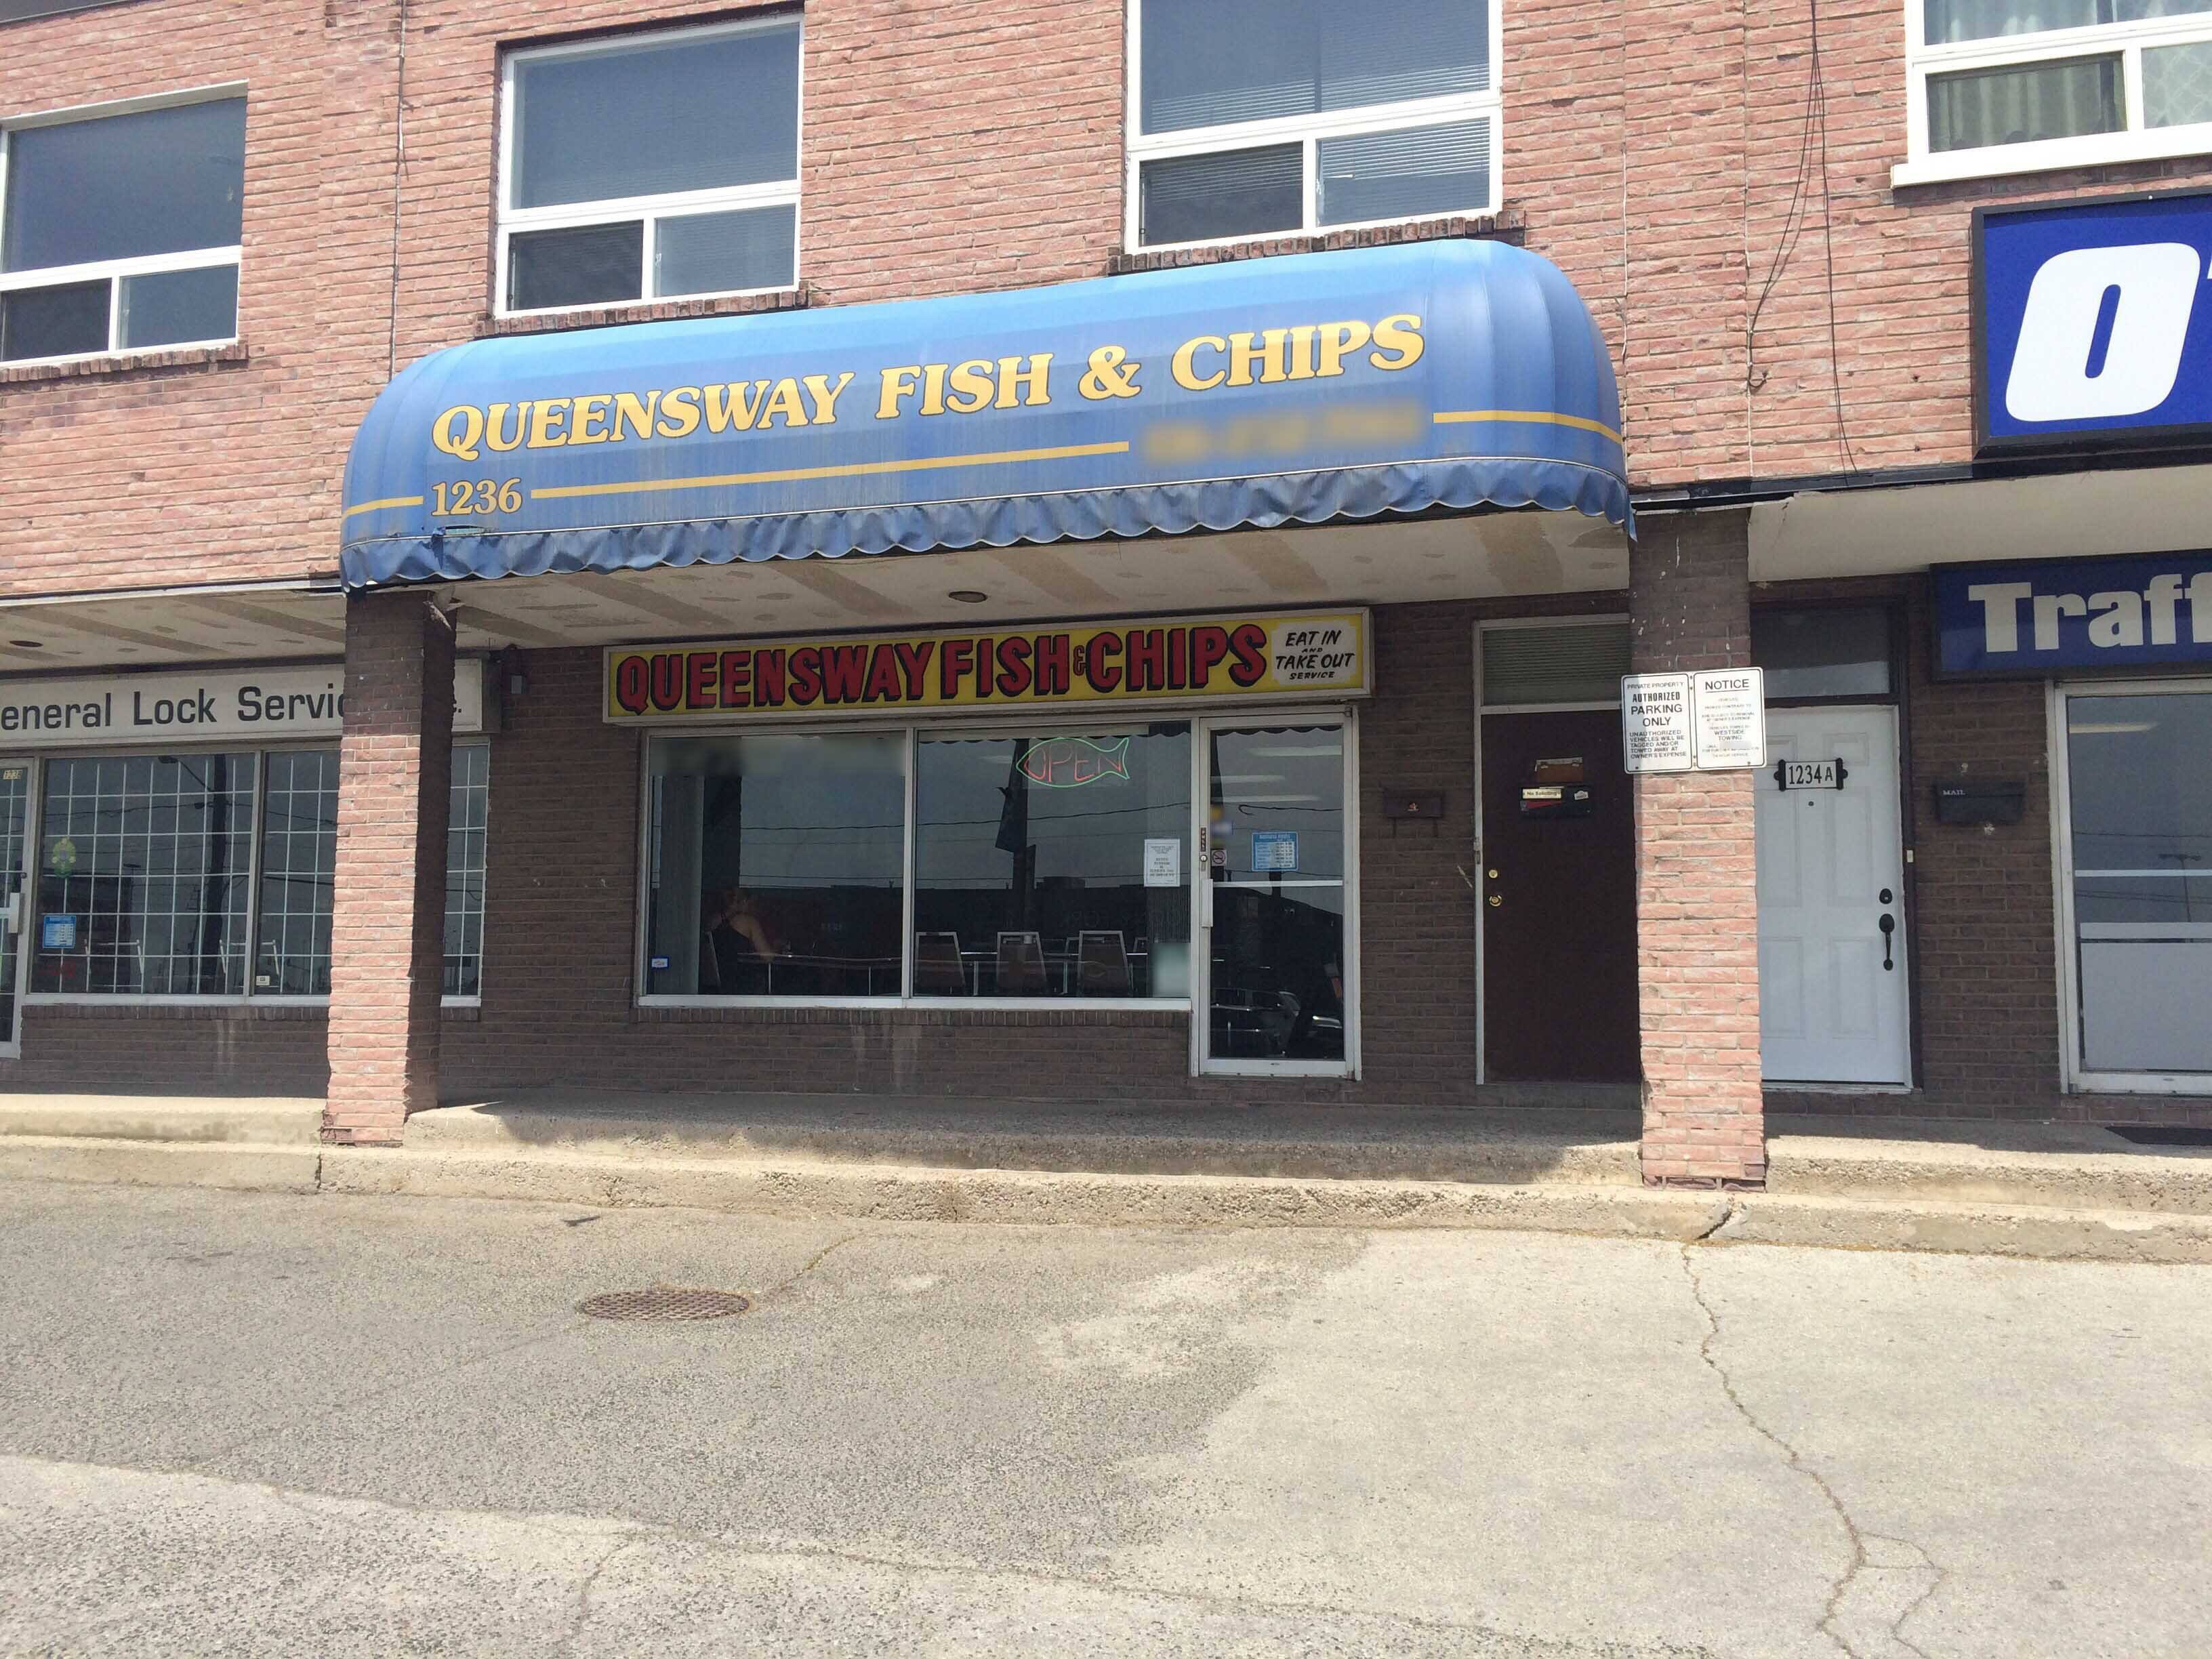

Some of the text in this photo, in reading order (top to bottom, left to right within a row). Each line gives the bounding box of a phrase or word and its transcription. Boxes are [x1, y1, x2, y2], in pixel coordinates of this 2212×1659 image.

[2006, 242, 2212, 422] O
[431, 314, 1425, 462] QUEENSWAY FISH & CHIPS
[431, 477, 523, 516] 1236
[1286, 630, 1342, 647] EAT IN
[616, 641, 936, 716] QUEENSWAY
[940, 634, 1070, 700] FISH
[1085, 623, 1267, 694] CHIPS
[1275, 653, 1355, 670] TAKE OUT
[1289, 671, 1335, 680] SERVICE
[1705, 679, 1750, 690] NOTICE
[1633, 691, 1680, 703] AUTHORIZED
[134, 688, 217, 726] Lock
[1631, 703, 1683, 715] PARKING
[1643, 716, 1671, 726] ONLY
[1024, 742, 1122, 782] OPEN
